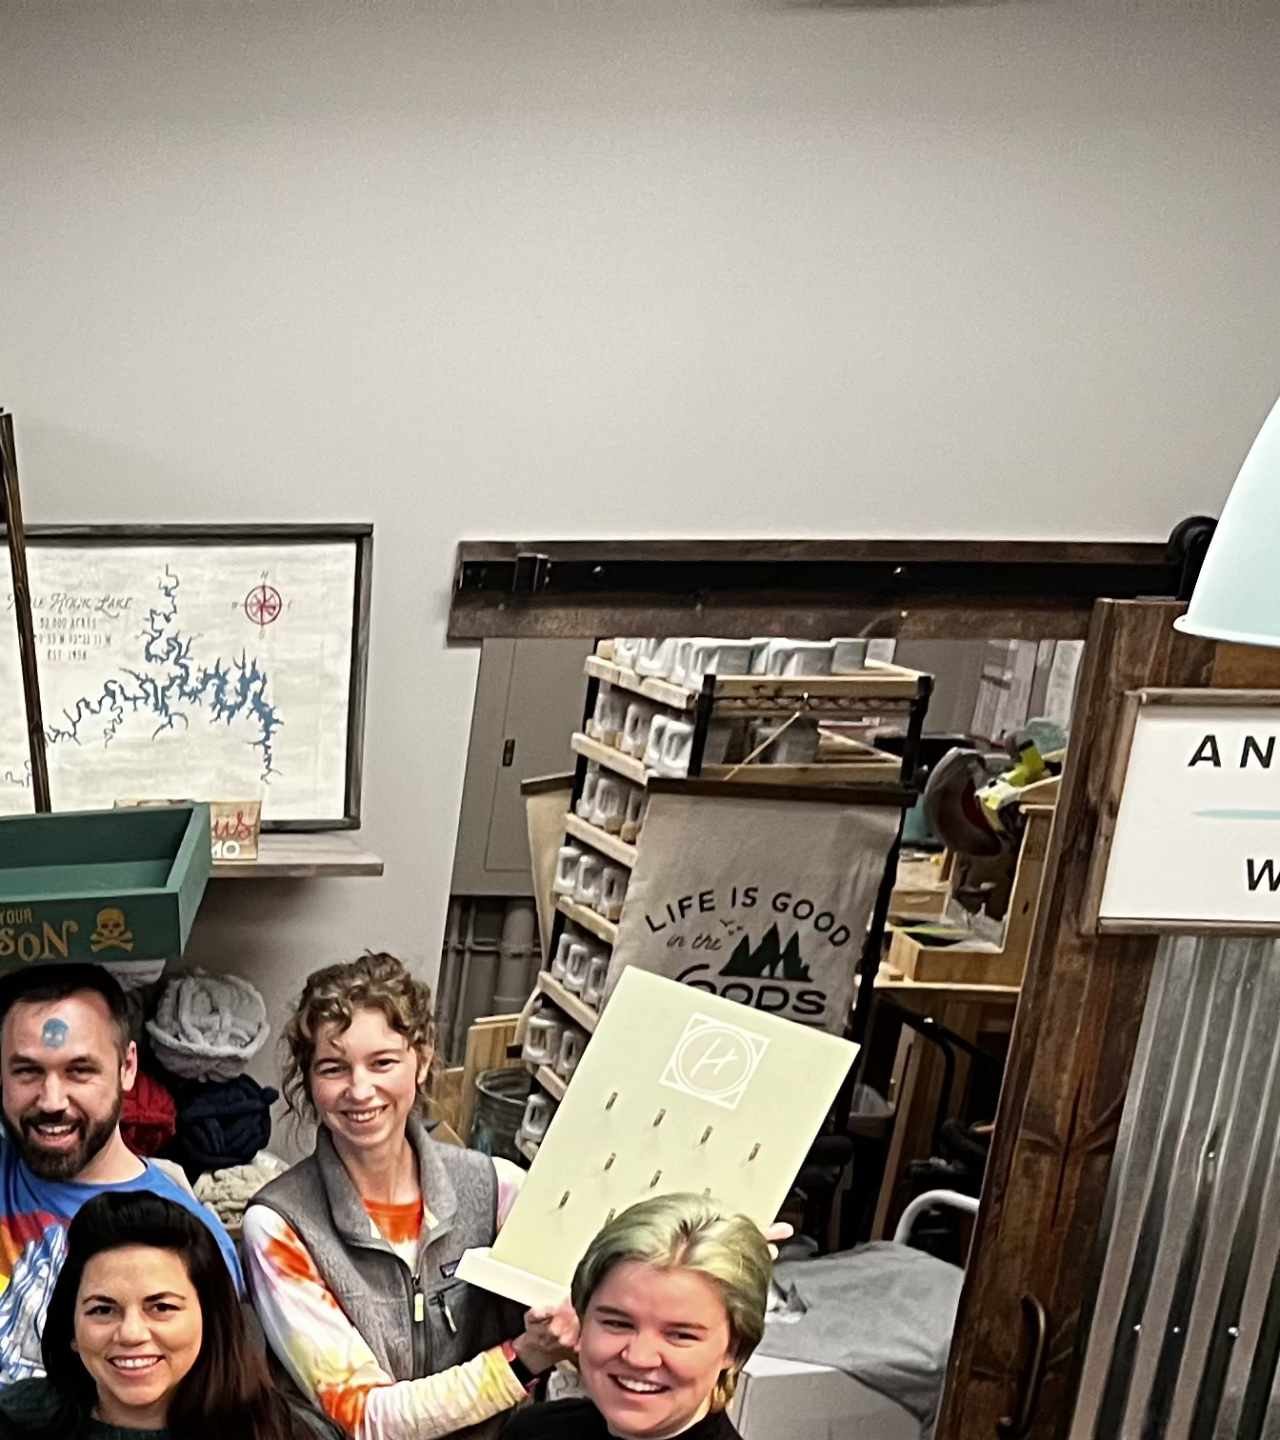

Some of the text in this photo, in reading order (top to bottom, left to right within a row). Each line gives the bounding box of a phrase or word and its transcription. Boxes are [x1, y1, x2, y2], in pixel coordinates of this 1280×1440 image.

[645, 886, 851, 948] LIFE IS GOOD
[667, 932, 722, 951] in the
